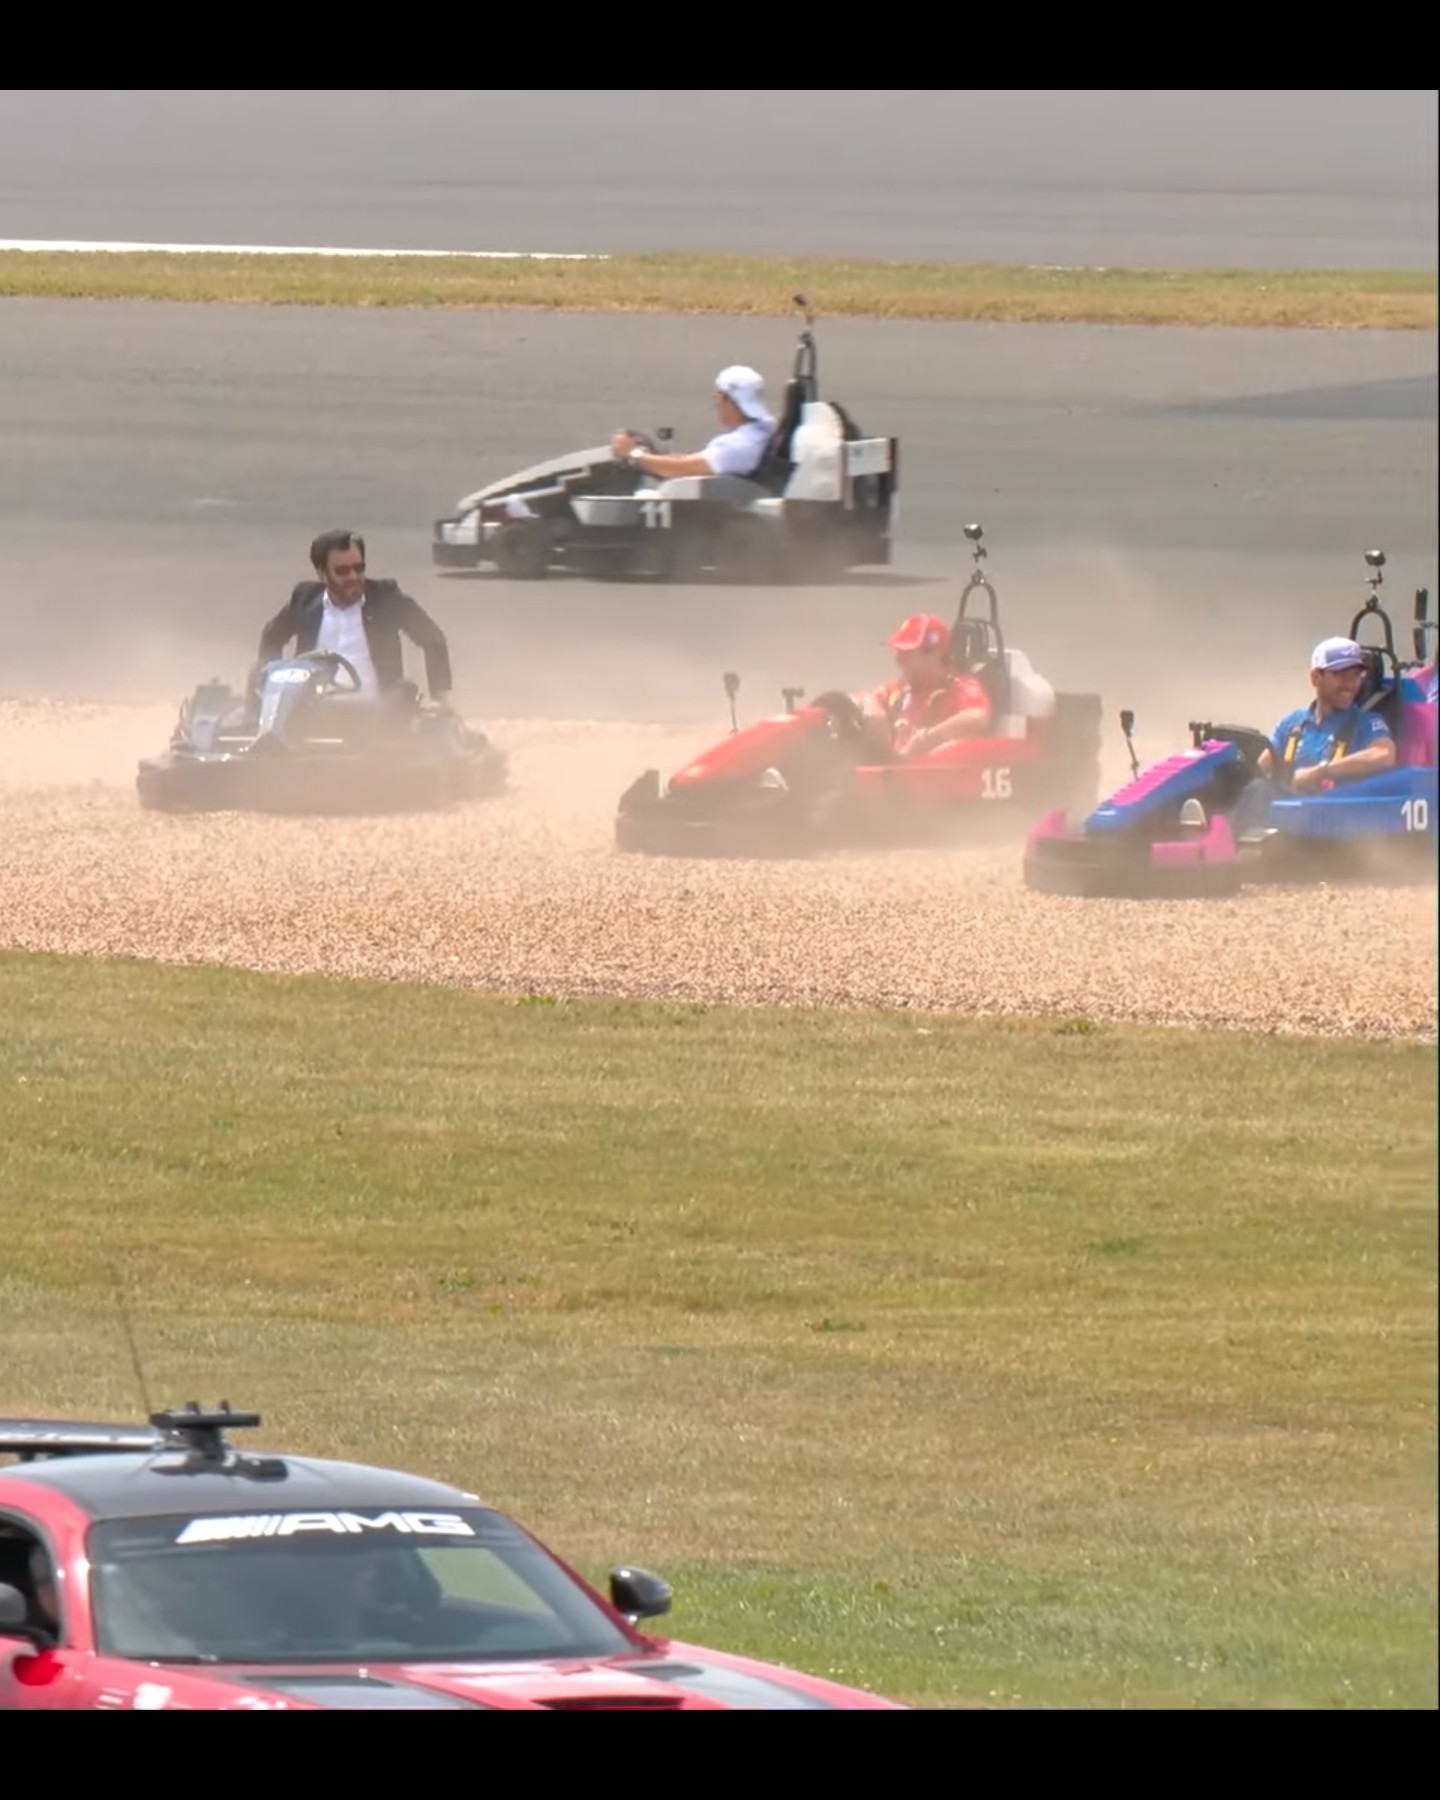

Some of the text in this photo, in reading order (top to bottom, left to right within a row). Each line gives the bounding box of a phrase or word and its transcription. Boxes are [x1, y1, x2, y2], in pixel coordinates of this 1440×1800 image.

[640, 501, 671, 528] 11
[981, 768, 1012, 799] 16
[1400, 799, 1428, 831] 10
[277, 1511, 475, 1536] AMG
